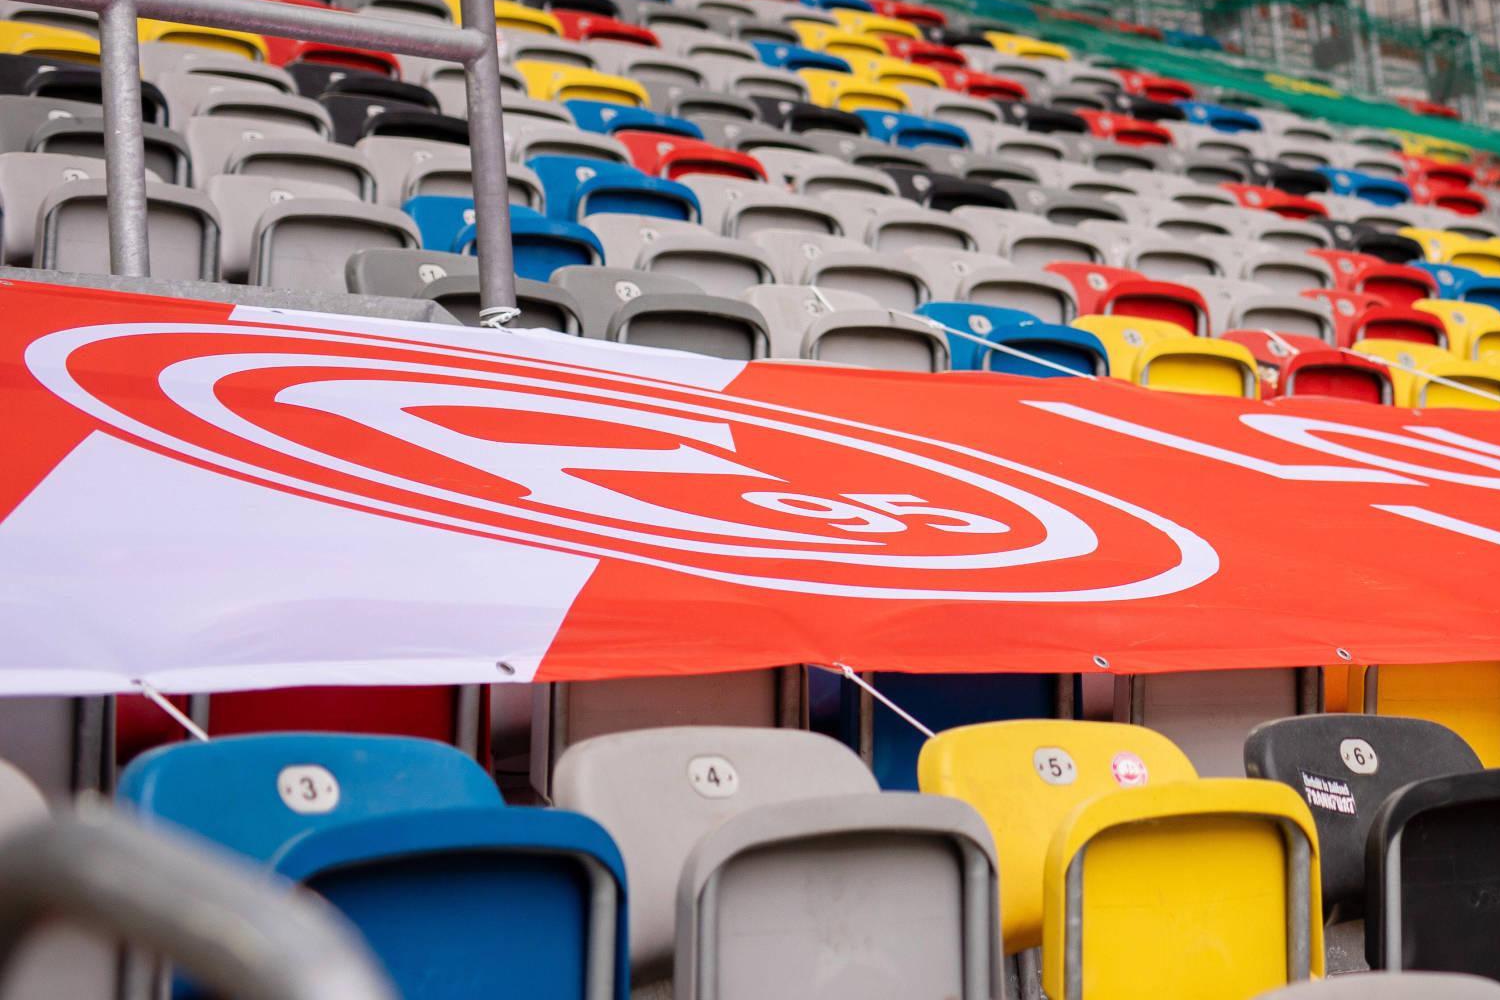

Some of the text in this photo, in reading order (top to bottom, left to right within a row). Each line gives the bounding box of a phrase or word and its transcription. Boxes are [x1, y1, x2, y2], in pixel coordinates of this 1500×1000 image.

[740, 491, 1012, 534] 95
[1354, 747, 1366, 765] 6
[707, 766, 721, 785] 4
[1049, 758, 1063, 777] 5
[300, 776, 318, 801] 3
